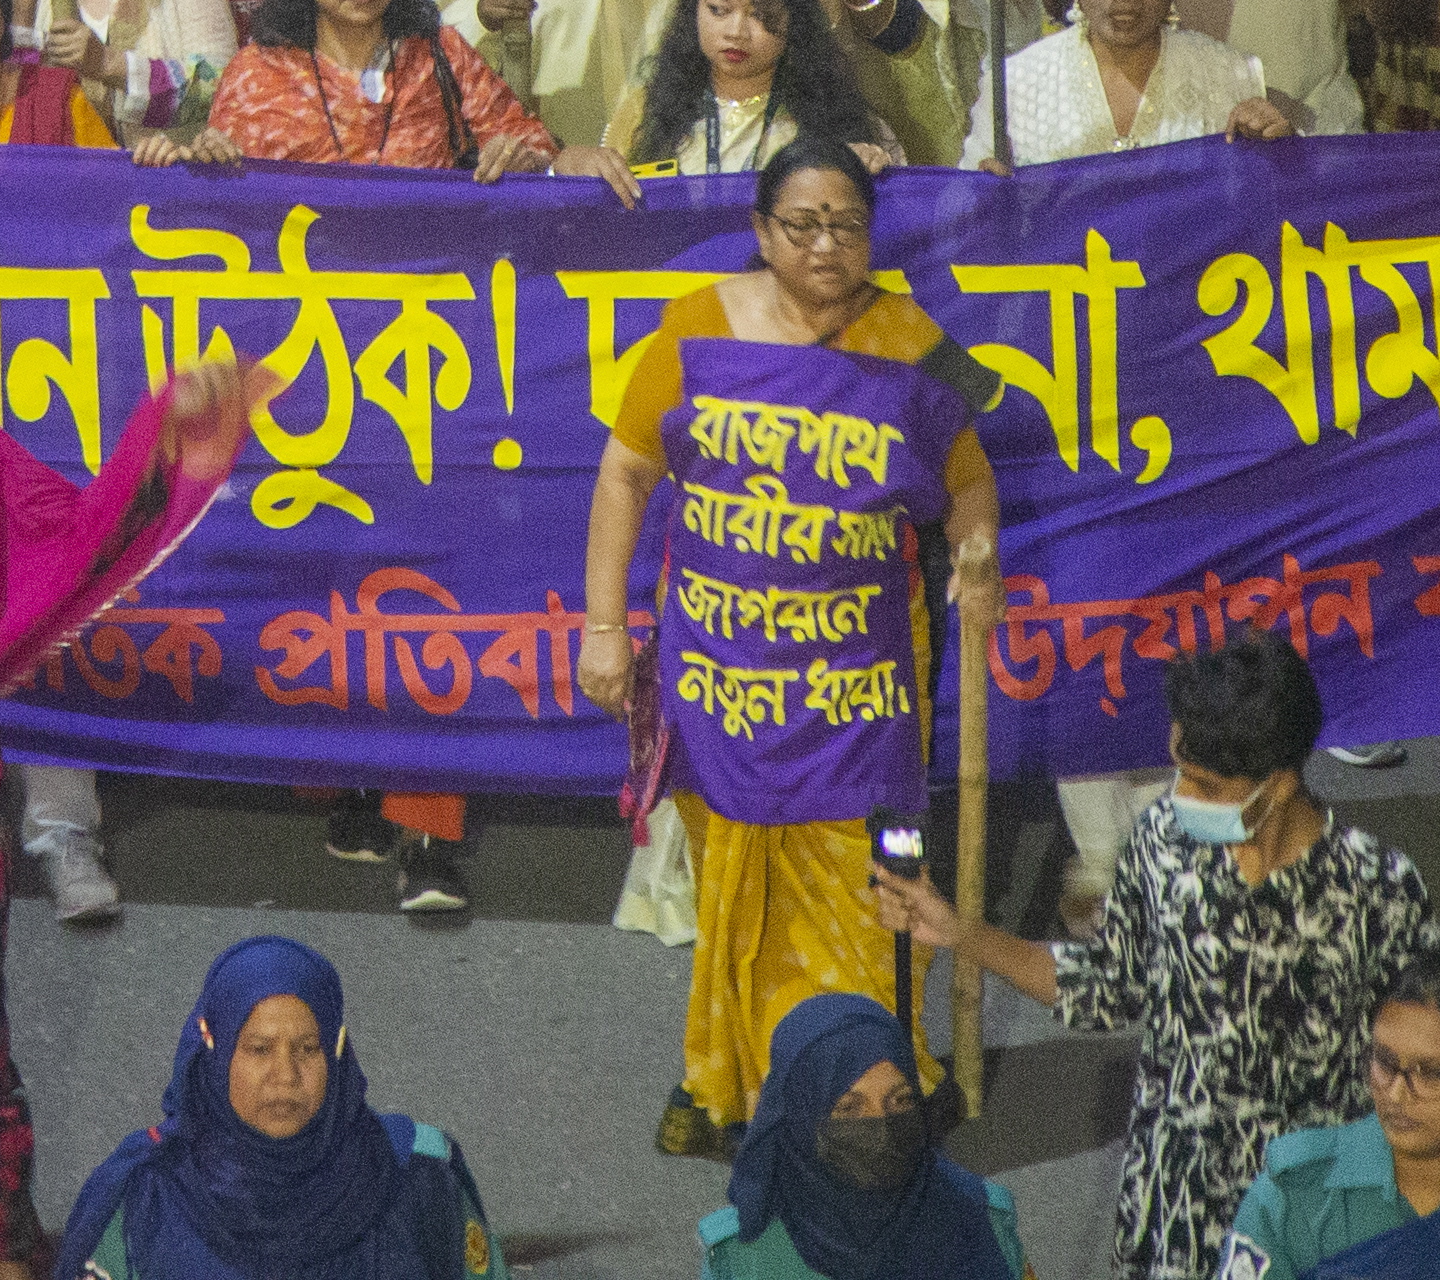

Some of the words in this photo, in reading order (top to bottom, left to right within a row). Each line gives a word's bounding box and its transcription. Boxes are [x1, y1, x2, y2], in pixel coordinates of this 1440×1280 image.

[688, 395, 905, 489] রাজপথে
[683, 474, 838, 564] নারীর
[677, 651, 799, 741] নতুন
